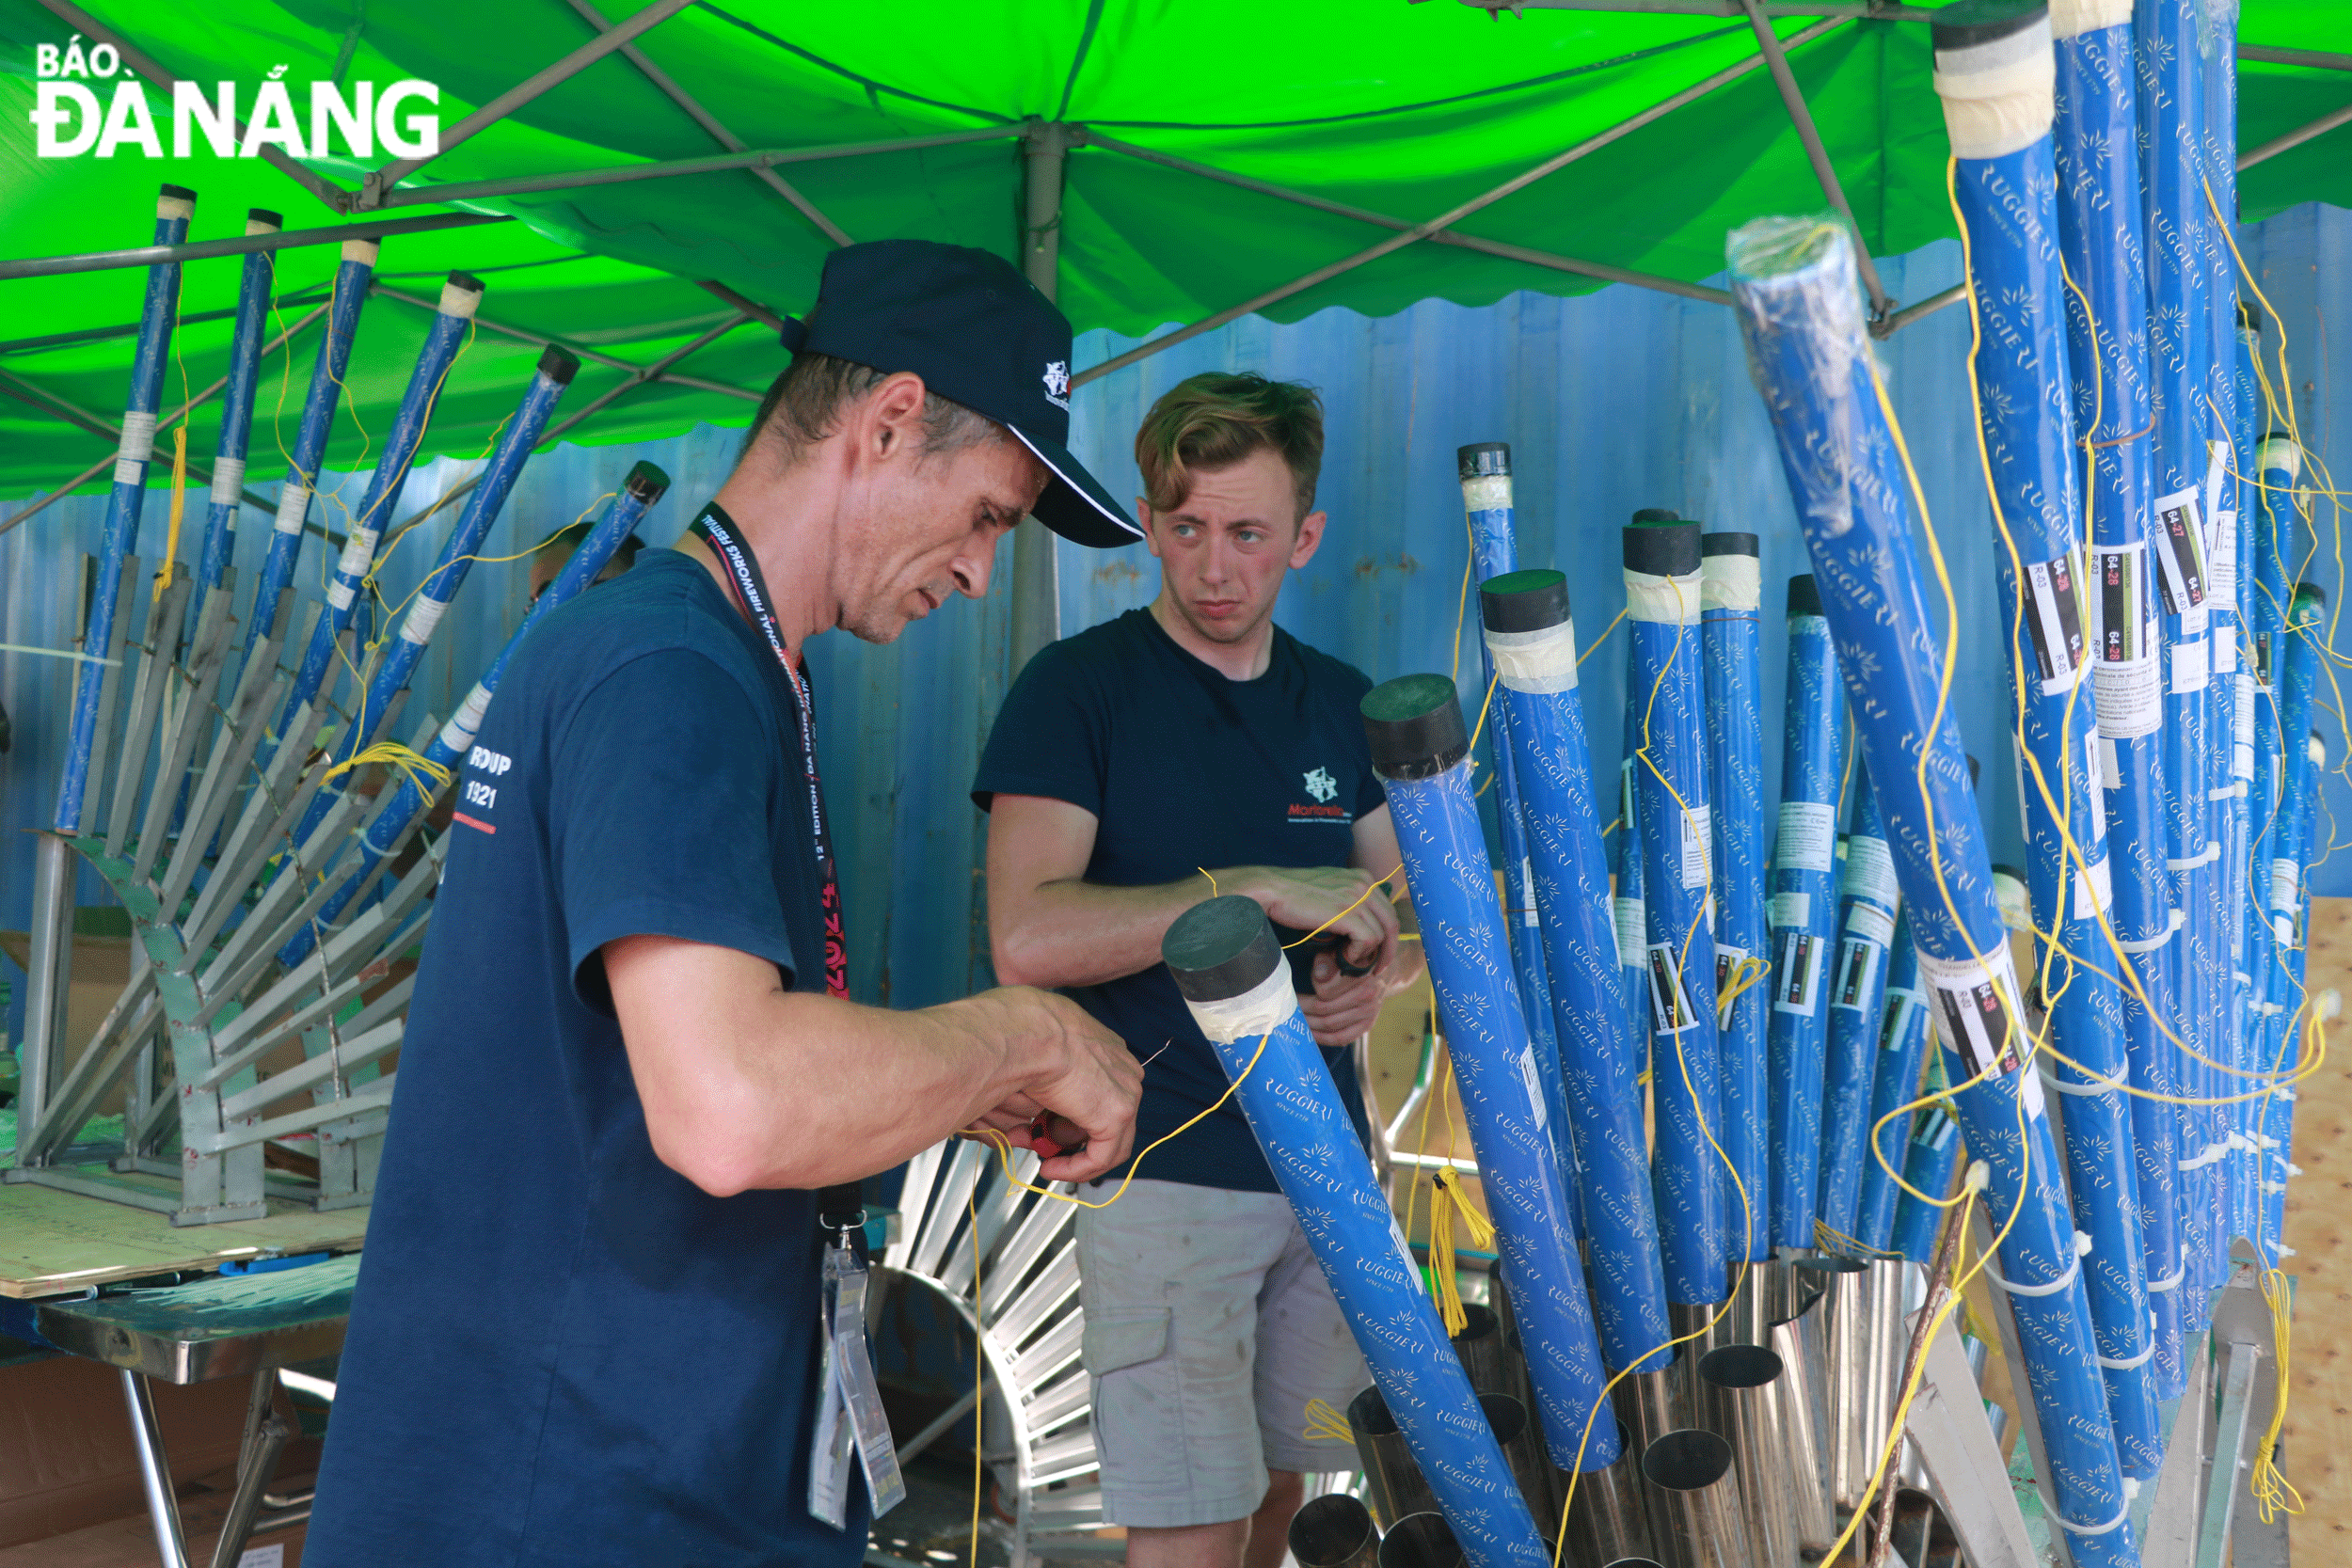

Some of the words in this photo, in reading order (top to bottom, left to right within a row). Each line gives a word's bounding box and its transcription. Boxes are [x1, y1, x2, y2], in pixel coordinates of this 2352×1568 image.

[1981, 164, 2056, 261] RUGGIERI
[2152, 208, 2203, 289] RUGGIERI
[702, 514, 734, 546] FESTIVAL
[2168, 510, 2185, 537] 64-27
[725, 545, 766, 612] FIREWORKS
[2033, 566, 2046, 588] R-03
[2107, 555, 2120, 586] 64-28
[2188, 577, 2202, 603] 64-27
[2177, 592, 2188, 611] R-03
[2055, 654, 2068, 675] R-03
[2109, 631, 2121, 660] 64-28
[802, 710, 811, 753] NANG
[807, 755, 815, 775] DA
[810, 784, 821, 835] EDITION
[1522, 801, 1572, 866] RUGGIERI
[1444, 851, 1494, 903] RUGGIERI
[1438, 919, 1498, 976] RUGGIERI
[1437, 979, 1495, 1044] RUGGIERI
[1561, 999, 1611, 1059] RUGGIERI
[1265, 1078, 1333, 1121] RUGGIERI
[1496, 1111, 1549, 1158] RUGGIERI
[1269, 1139, 1343, 1193] RUGGIERI
[1490, 1169, 1547, 1223] RUGGIERI
[1357, 1257, 1414, 1290] RUGGIERI
[2097, 1258, 2148, 1307] RUGGIERI
[1358, 1312, 1424, 1354] RUGGIERI
[1541, 1339, 1595, 1384] RUGGIERI
[1436, 1459, 1497, 1494] RUGGIERI
[2054, 1459, 2114, 1503] RUGGIERI
